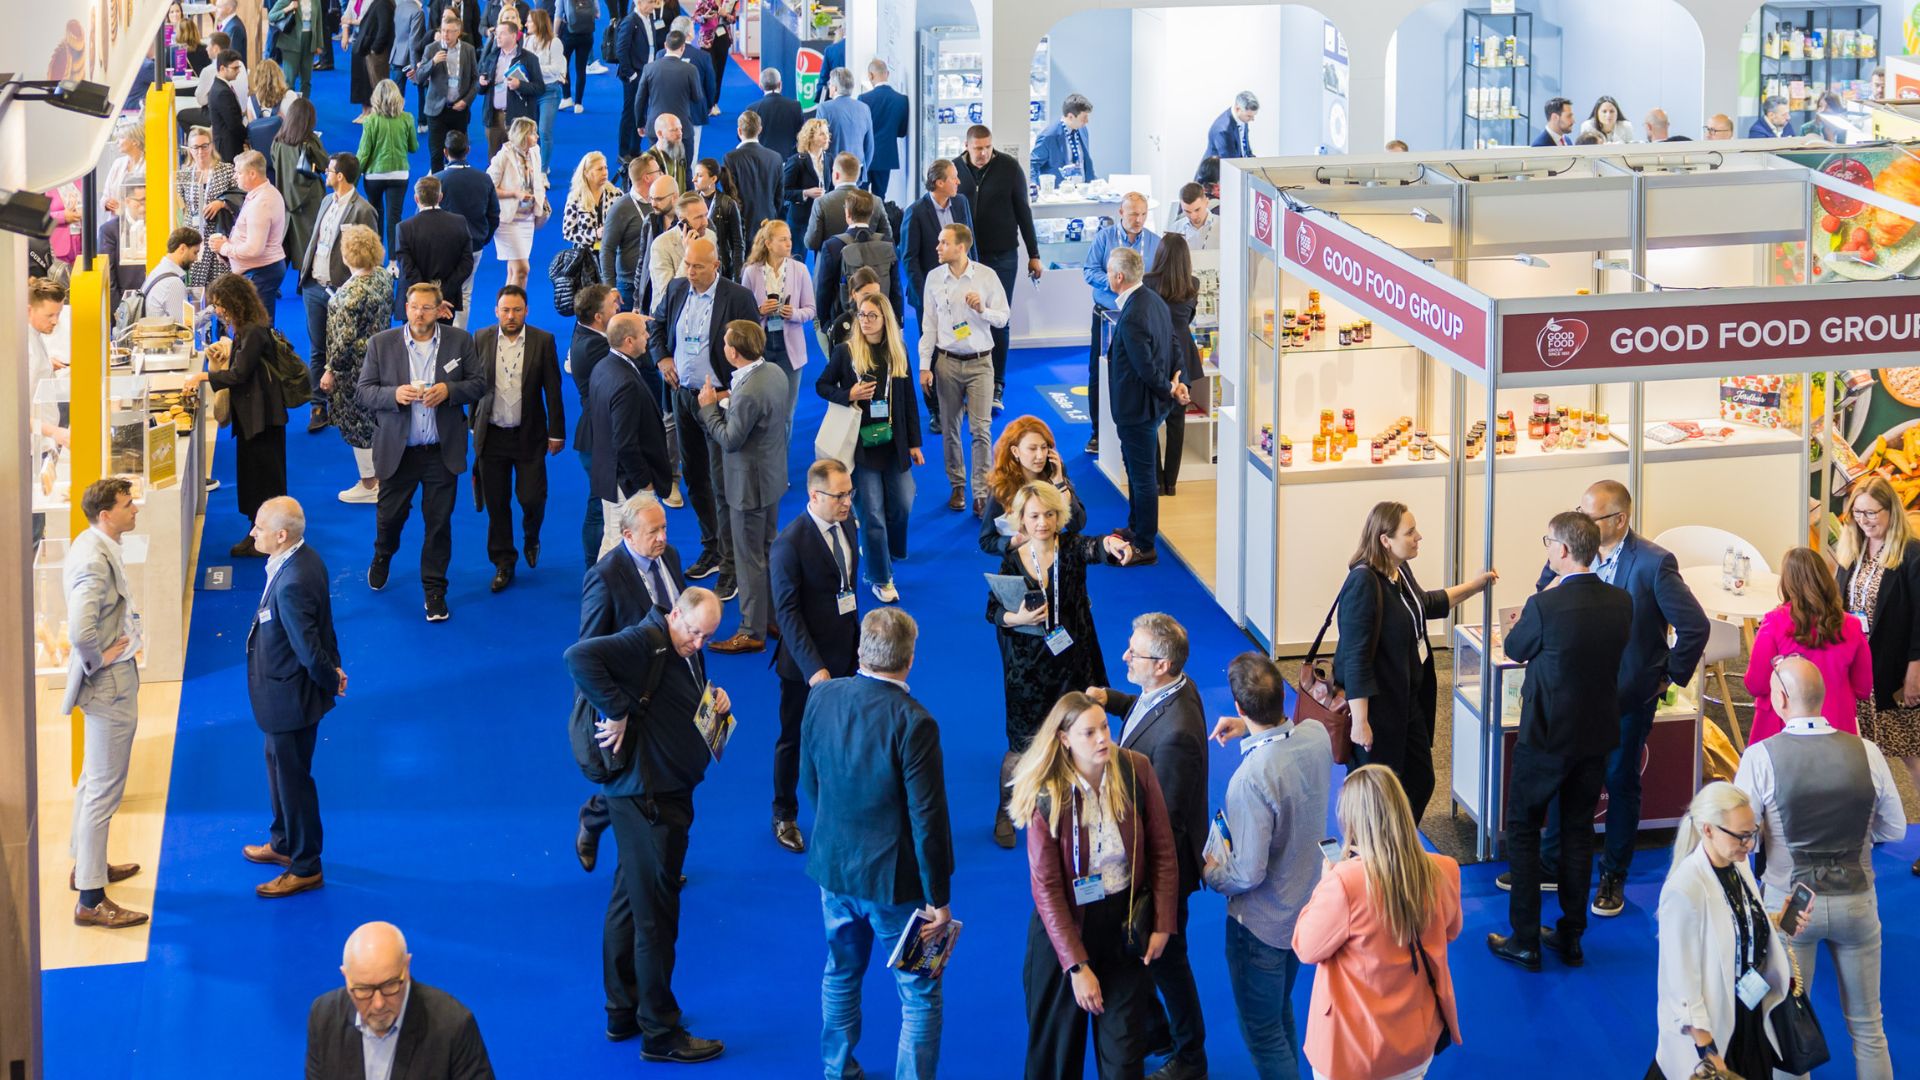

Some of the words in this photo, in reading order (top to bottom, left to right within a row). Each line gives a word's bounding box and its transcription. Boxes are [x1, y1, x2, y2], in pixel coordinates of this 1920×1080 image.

[1323, 246, 1362, 286] GOOD
[1365, 267, 1406, 310] FOOD
[1409, 292, 1464, 340] GROUP
[1547, 332, 1575, 341] GOOD
[1548, 339, 1575, 348] FOOD
[1610, 324, 1709, 354] GOOD
[1719, 319, 1811, 349] FOOD
